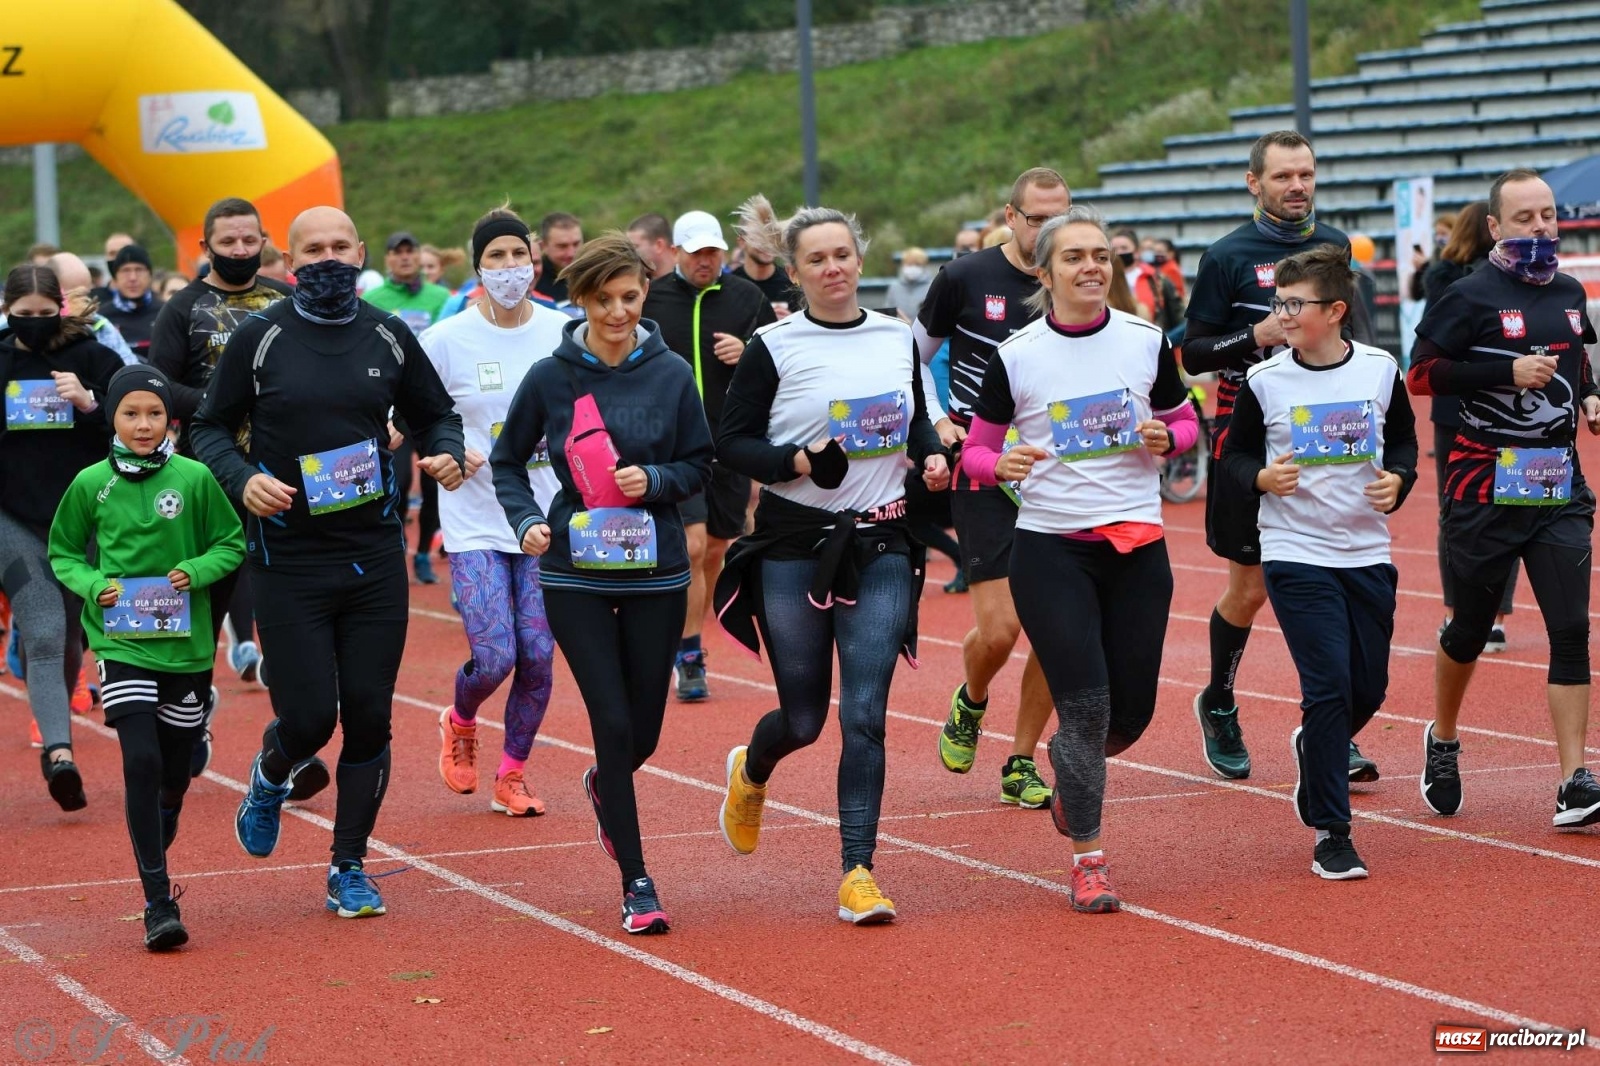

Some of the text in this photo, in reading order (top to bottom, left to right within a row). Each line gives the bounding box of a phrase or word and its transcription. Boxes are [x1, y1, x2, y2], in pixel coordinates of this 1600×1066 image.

[47, 412, 67, 422] 213
[861, 418, 875, 426] DLA
[1061, 420, 1079, 430] BIEG
[1083, 417, 1098, 426] DLA
[1302, 425, 1319, 433] BIEG
[878, 432, 901, 448] 284
[1103, 431, 1131, 447] 047
[1342, 439, 1369, 456] 286
[314, 473, 331, 483] BIEG
[334, 469, 349, 479] DLA
[355, 480, 377, 496] 028
[1542, 487, 1565, 500] 218
[602, 529, 617, 537] DLA
[624, 548, 649, 560] 031
[135, 599, 150, 607] DLA
[153, 618, 181, 631] 027
